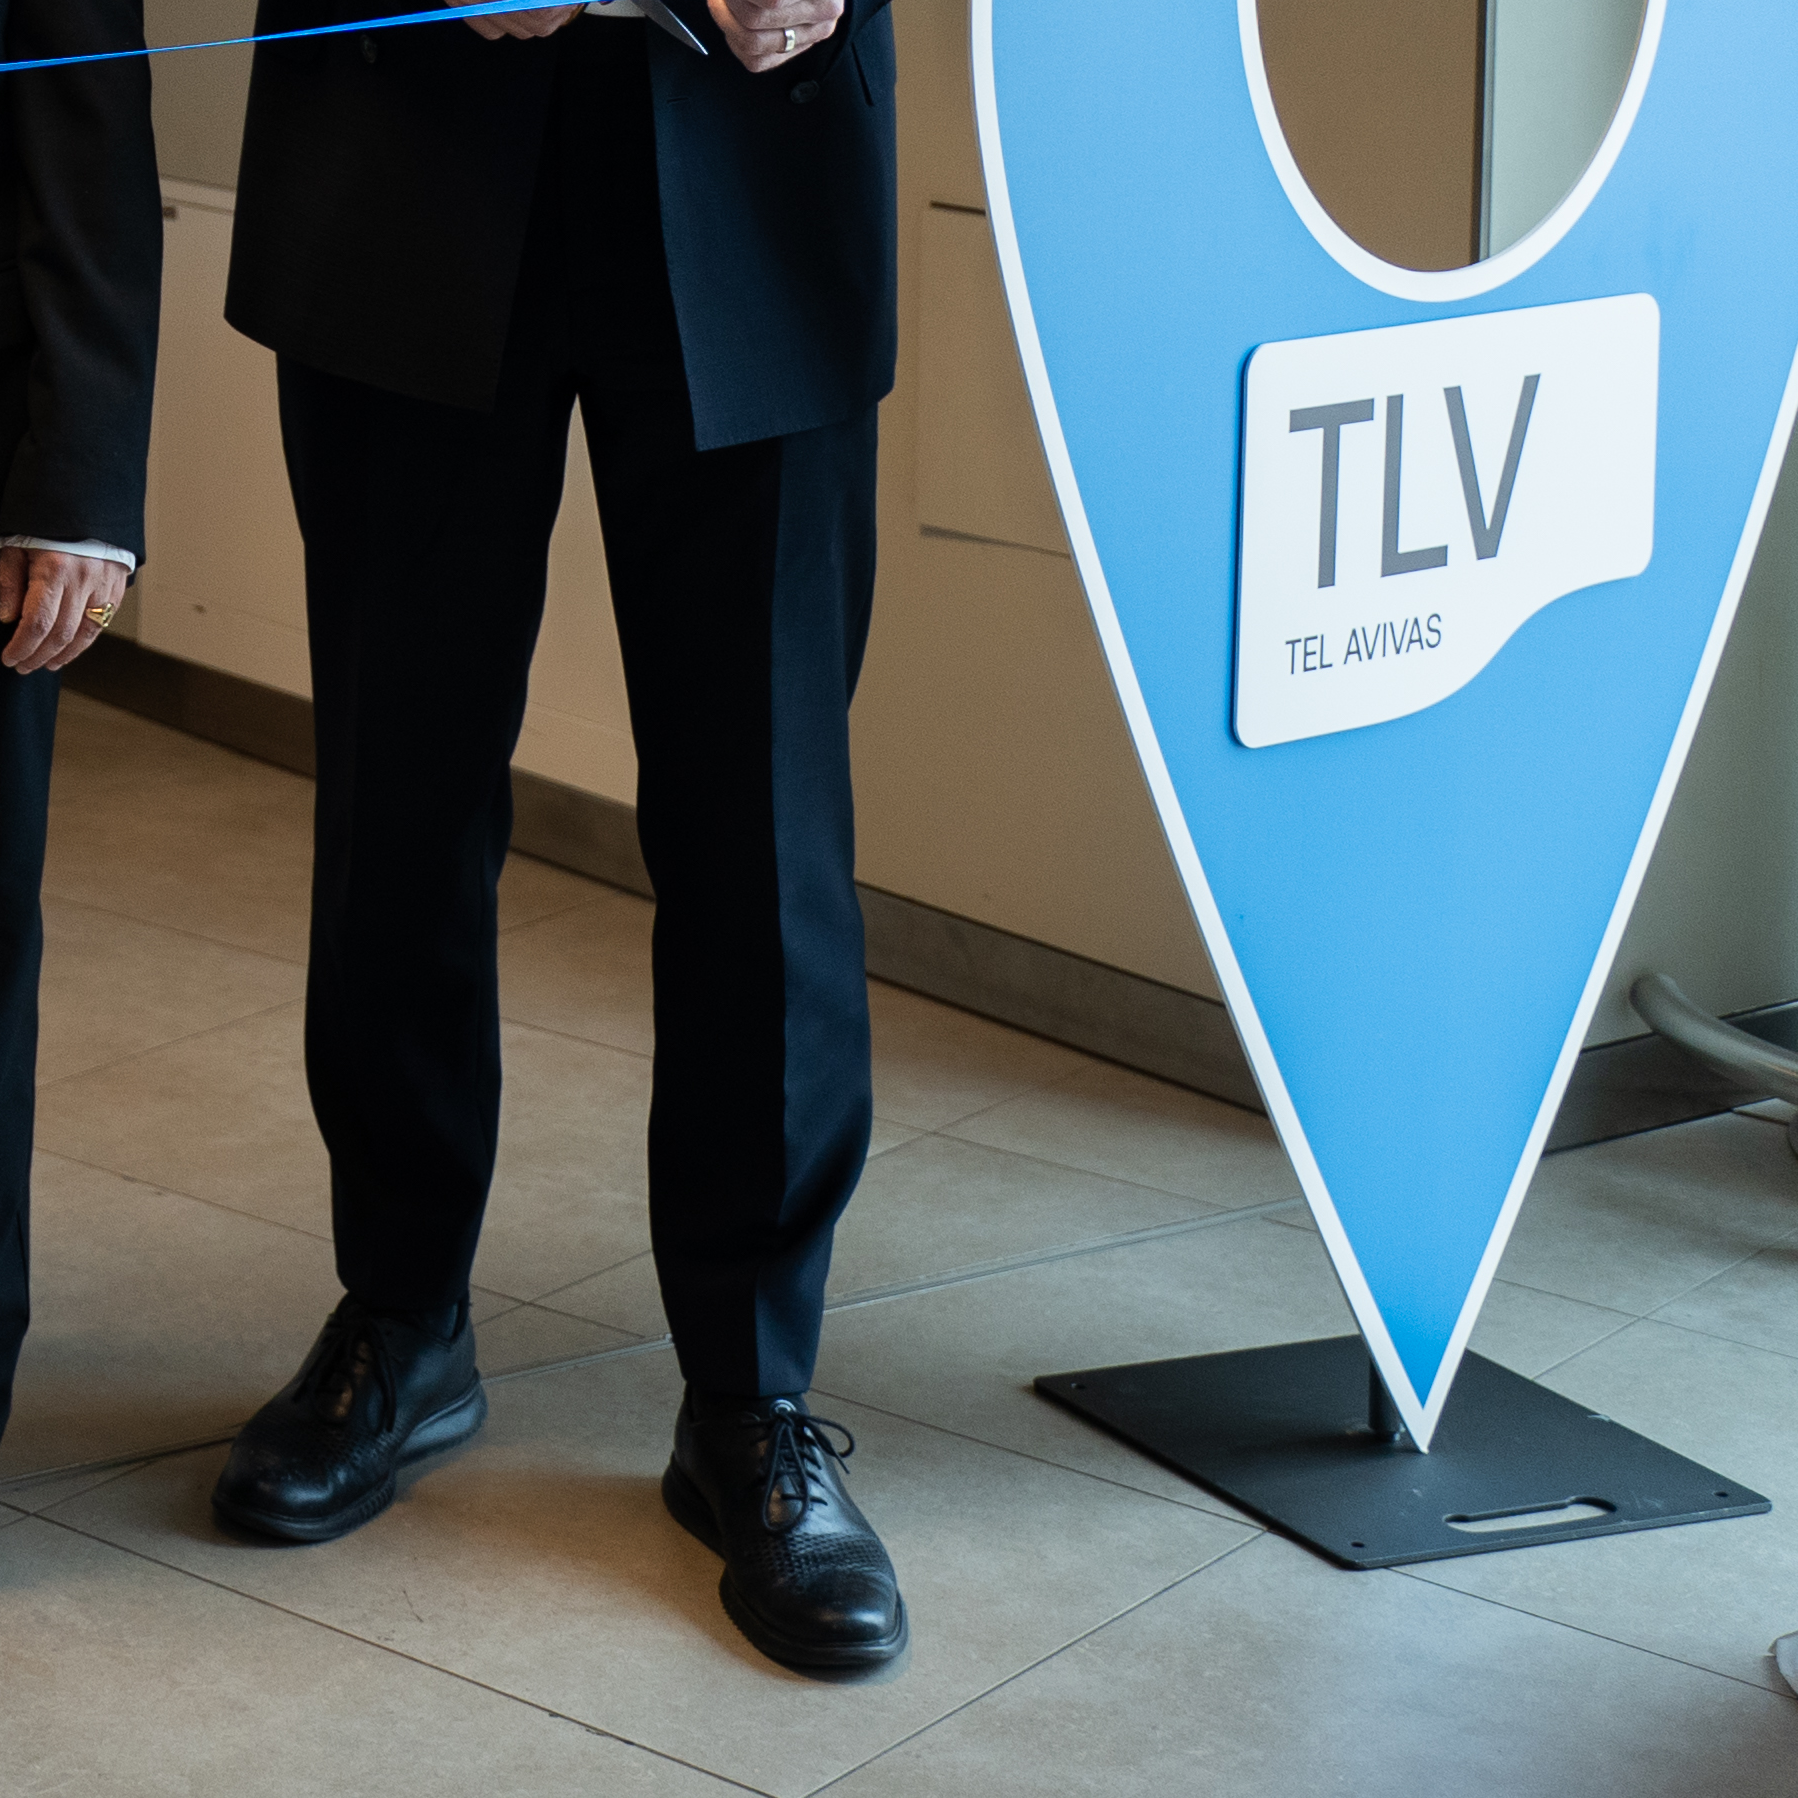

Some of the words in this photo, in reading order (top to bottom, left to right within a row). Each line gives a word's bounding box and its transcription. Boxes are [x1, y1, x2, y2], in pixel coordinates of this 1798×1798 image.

[1289, 373, 1542, 589] TLV
[1285, 634, 1333, 676] TEL
[1343, 613, 1443, 666] AVIVAS
